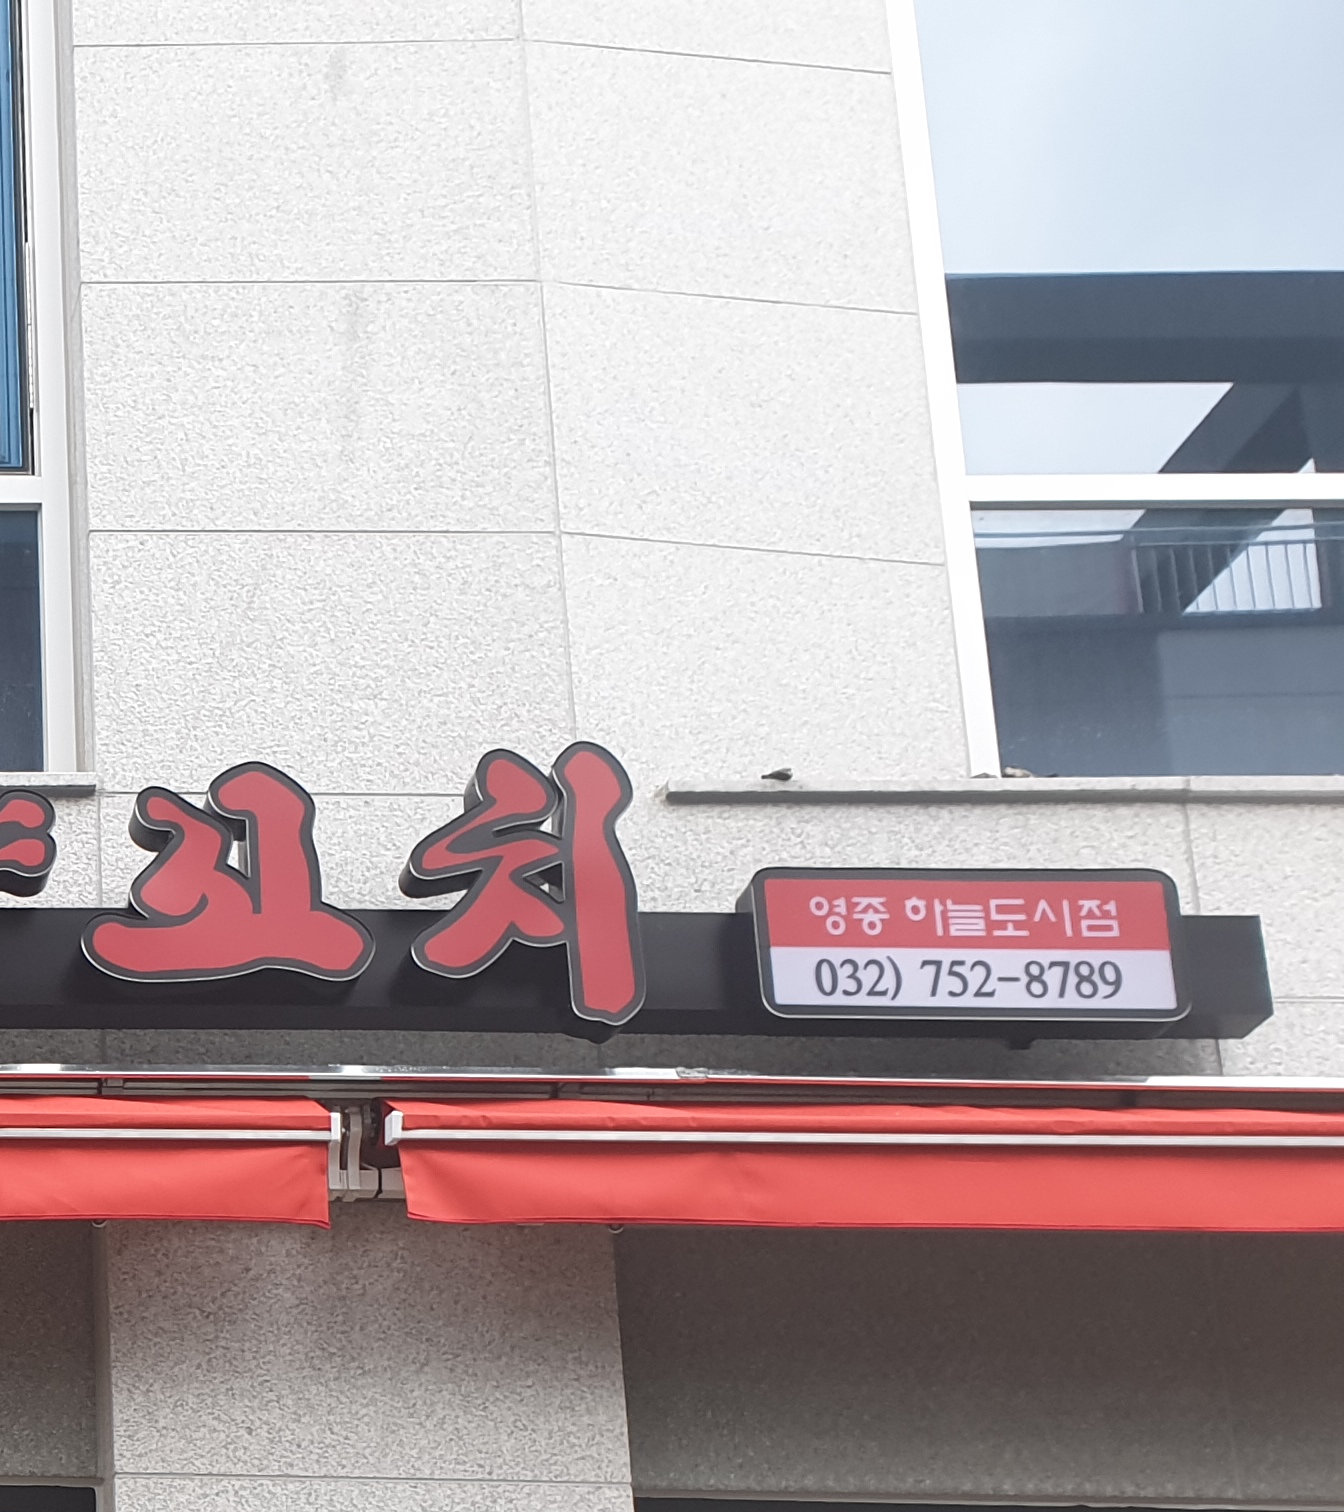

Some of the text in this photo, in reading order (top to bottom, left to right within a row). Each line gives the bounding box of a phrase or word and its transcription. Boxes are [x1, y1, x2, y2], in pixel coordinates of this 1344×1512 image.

[809, 895, 1121, 938] 영종 하늘도시점
[814, 955, 1123, 1001] 032) 752-8789
